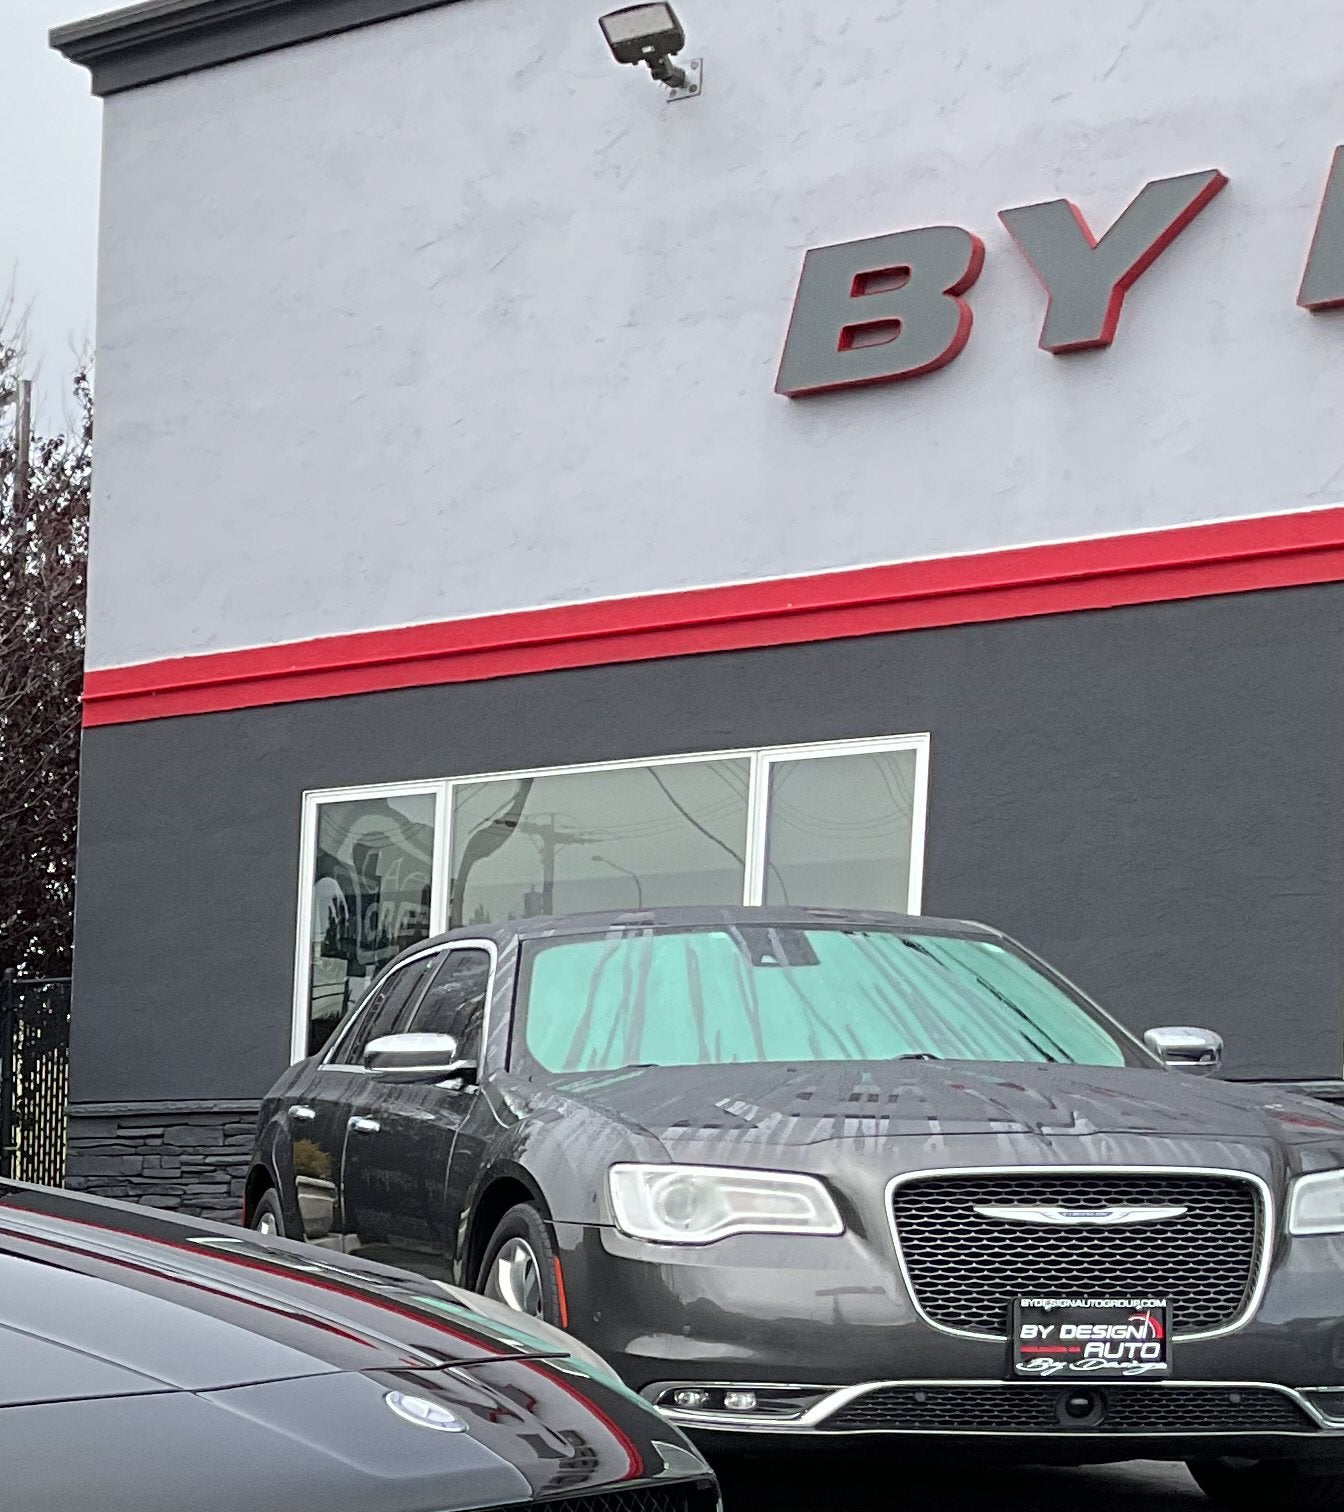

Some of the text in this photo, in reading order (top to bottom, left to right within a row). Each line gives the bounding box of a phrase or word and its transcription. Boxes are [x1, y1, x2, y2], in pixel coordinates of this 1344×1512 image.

[774, 169, 1229, 400] BY
[1020, 1324, 1146, 1339] BY DESIGN
[1083, 1341, 1161, 1359] AUTO
